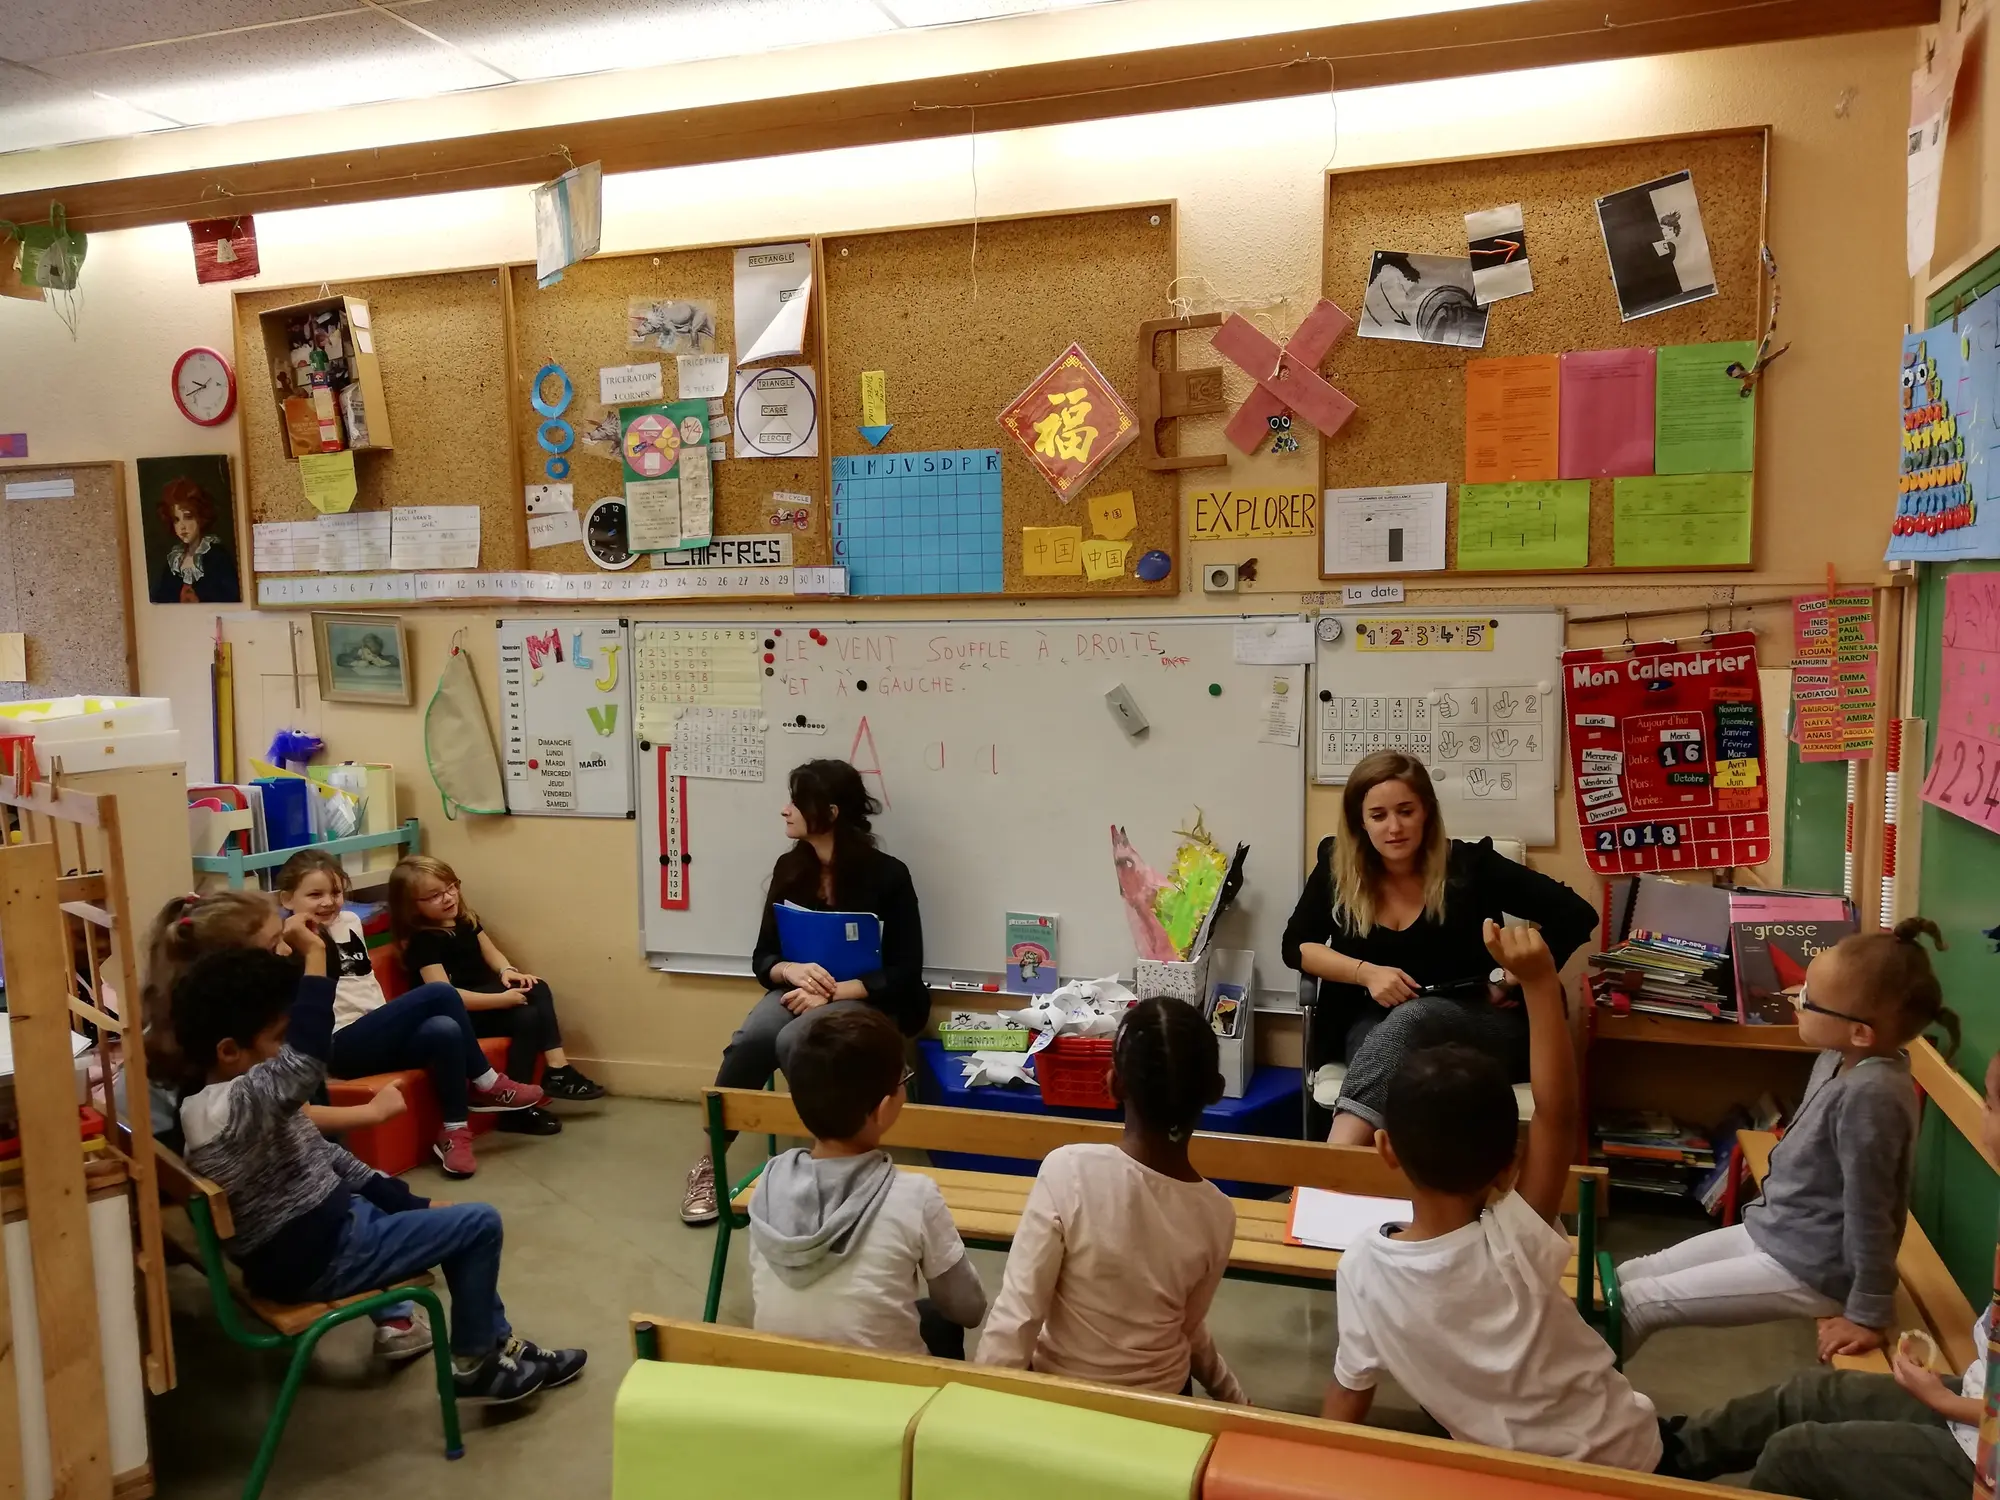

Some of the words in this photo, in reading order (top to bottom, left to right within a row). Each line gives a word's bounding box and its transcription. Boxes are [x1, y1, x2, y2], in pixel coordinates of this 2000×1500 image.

[750, 253, 793, 265] RECTANGLE
[605, 373, 657, 384] TRICERATOPS
[758, 378, 794, 388] TRIANGLE
[1033, 388, 1099, 463] 福
[761, 434, 791, 442] CERCLE
[852, 461, 859, 475] L
[867, 460, 876, 475] M
[886, 459, 896, 474] J
[904, 458, 915, 472] V
[924, 458, 935, 472] S
[942, 458, 953, 471] D
[963, 457, 972, 471] P
[986, 456, 998, 471] R
[836, 483, 844, 495] A
[613, 505, 619, 513] 12
[836, 503, 843, 515] E
[1103, 508, 1122, 520] 中国
[1196, 492, 1315, 532] EXPLORER
[531, 524, 554, 534] TROIS
[838, 523, 842, 536] I
[836, 540, 846, 555] O
[1034, 537, 1075, 565] 中国
[664, 541, 781, 565] CHIFFRES
[1088, 549, 1126, 569] 中国
[602, 581, 612, 589] 20
[622, 580, 631, 588] 21
[640, 580, 649, 588] 22
[659, 579, 668, 587] 23
[677, 578, 686, 586] 24
[697, 577, 707, 586] 25
[718, 577, 727, 586] 26
[738, 577, 748, 586] 27
[760, 576, 769, 585] 28
[778, 575, 788, 584] 29
[800, 575, 808, 584] 30
[817, 575, 824, 584] 31
[1347, 588, 1362, 599] La
[1371, 586, 1398, 597] date
[1799, 600, 1826, 612] CHLOE
[1811, 618, 1828, 626] INES
[1838, 613, 1871, 624] DAPHNE
[1803, 628, 1828, 637] HUGO
[1839, 625, 1859, 633] PAUL
[1366, 630, 1376, 645] 1
[1390, 629, 1404, 645] 2
[1417, 626, 1428, 645] 3
[1440, 626, 1453, 643] 4
[1466, 626, 1482, 645] 5
[1838, 634, 1864, 642] AFDAL
[525, 628, 565, 669] M
[573, 632, 594, 669] L
[785, 638, 809, 662] LE
[835, 636, 898, 663] VENT
[1036, 630, 1050, 660] À
[1800, 647, 1832, 656] ELOUAN
[1838, 654, 1868, 662] HARON
[595, 645, 622, 692] J
[1572, 665, 1619, 689] Mon
[1628, 651, 1750, 681] Calendrier
[1797, 675, 1828, 683] DORIAN
[788, 677, 809, 696] ET
[1847, 687, 1869, 695] NAIA
[1796, 689, 1837, 699] KADIATOU
[1351, 699, 1357, 707] 2
[1471, 697, 1478, 714] 1
[1525, 695, 1537, 713] 2
[1719, 704, 1753, 713] Novembre
[1801, 705, 1834, 713] AMIROU
[586, 704, 618, 735] V
[1585, 717, 1605, 725] Lundi
[1637, 714, 1689, 731] Aujourd'hui
[1804, 719, 1831, 727] NAIYA
[1846, 714, 1874, 722] AMIRA
[1670, 732, 1691, 740] Mardi
[1722, 728, 1751, 737] Janvier
[1806, 731, 1831, 739] ANAIS
[538, 738, 572, 746] DIMANCHE
[1329, 734, 1335, 742] 6
[1351, 734, 1357, 742] 7
[1373, 734, 1379, 742] 8
[1395, 734, 1401, 742] 9
[1414, 734, 1427, 742] 10
[1469, 736, 1481, 753] 3
[1526, 735, 1537, 752] 4
[1722, 739, 1752, 749] Février
[546, 749, 564, 757] LUNDI
[1585, 751, 1617, 760] Mercredi
[1727, 750, 1747, 758] Mars
[545, 759, 566, 767] MARDI
[579, 760, 607, 769] MARDI
[1592, 764, 1612, 772] Jeudi
[1728, 760, 1747, 770] Avril
[541, 769, 571, 777] MERCREDI
[1674, 773, 1704, 783] Octobre
[1924, 744, 1943, 796] 1
[1940, 740, 1966, 803] 2
[1963, 744, 1985, 807] 3
[548, 780, 565, 788] JEUDI
[1501, 772, 1512, 790] 5
[1583, 777, 1613, 786] Vendredi
[1727, 778, 1744, 787] Juin
[543, 790, 572, 798] VENDREDI
[1589, 790, 1614, 802] Samedi
[546, 800, 569, 808] SAMEDI
[1589, 804, 1624, 820] Dimanche
[1741, 923, 1752, 931] La
[1754, 924, 1817, 940] grosse
[496, 1089, 516, 1103] N
